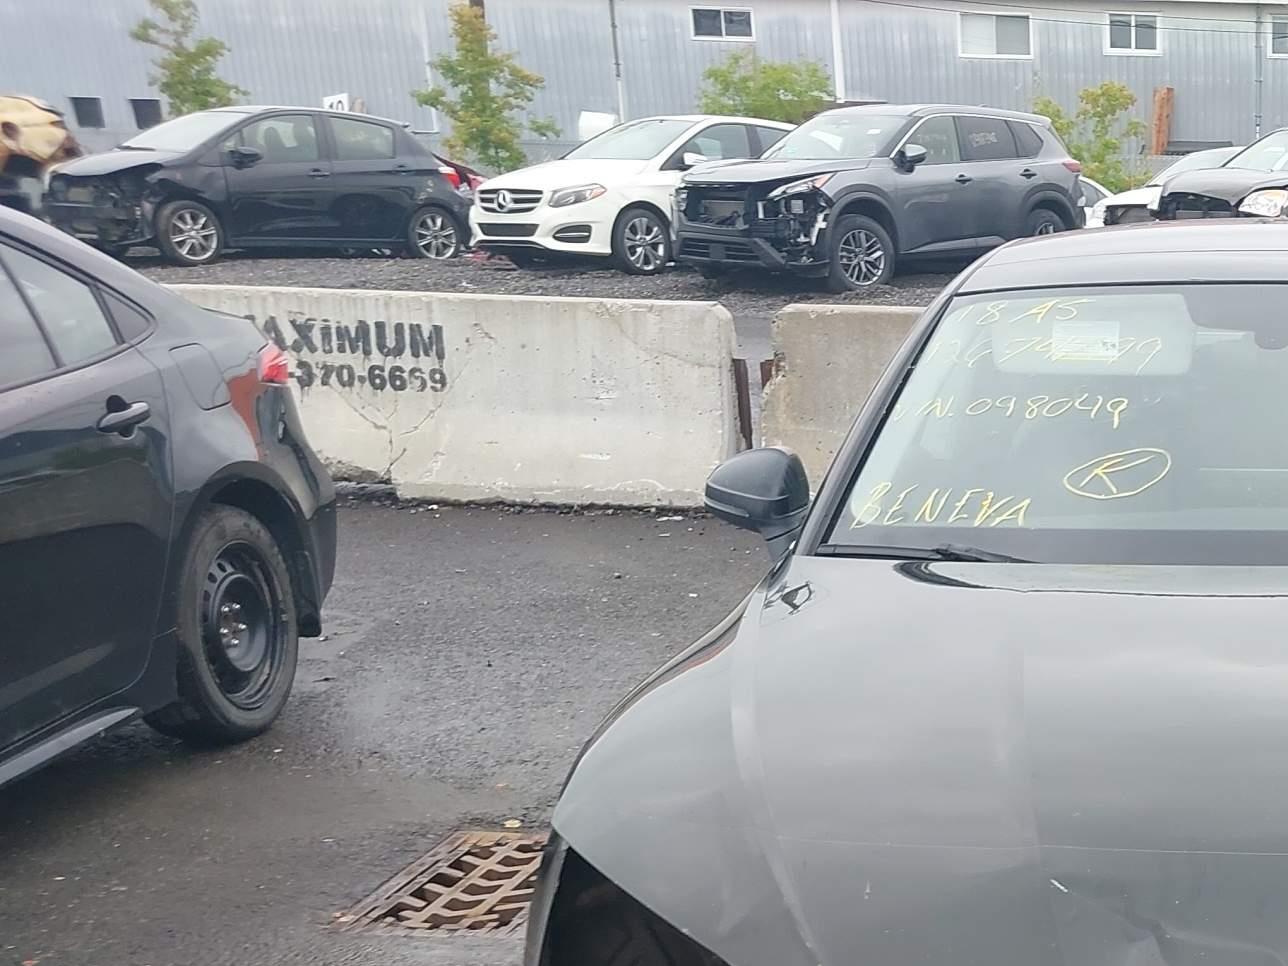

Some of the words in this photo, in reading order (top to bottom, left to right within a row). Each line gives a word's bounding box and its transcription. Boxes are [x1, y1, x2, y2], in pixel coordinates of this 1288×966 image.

[957, 300, 1009, 325] 18
[262, 313, 446, 361] AXIMUM
[849, 481, 1032, 530] BENEVA
